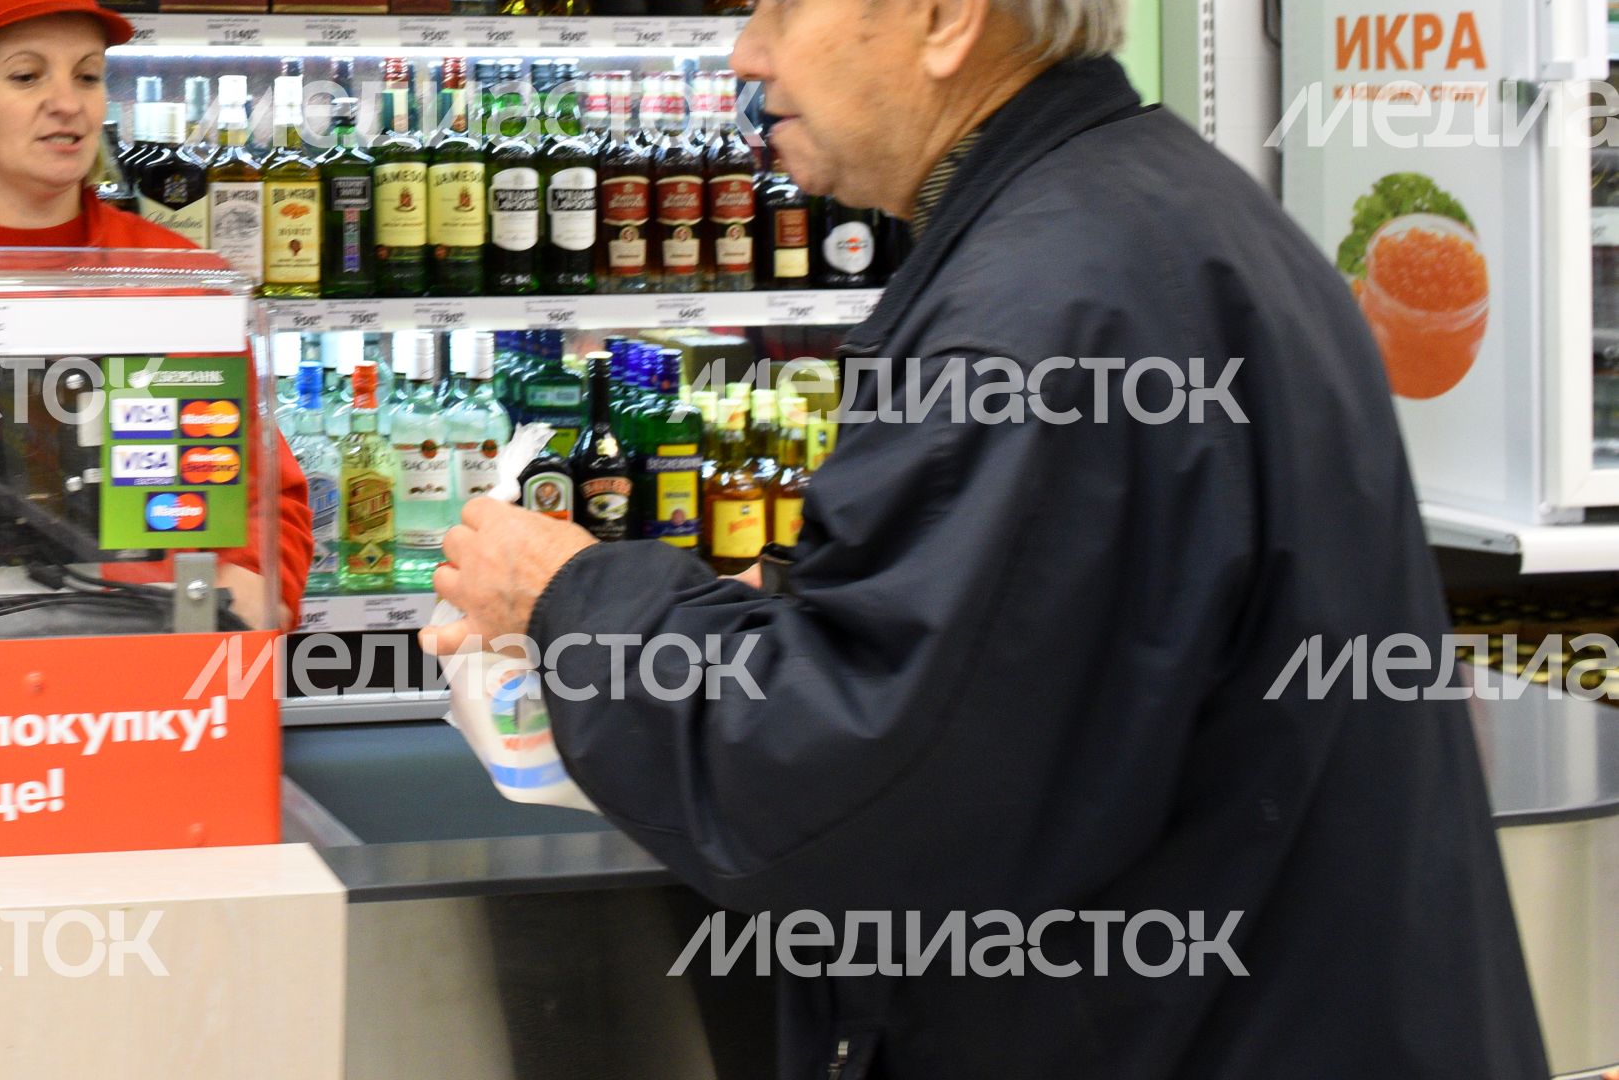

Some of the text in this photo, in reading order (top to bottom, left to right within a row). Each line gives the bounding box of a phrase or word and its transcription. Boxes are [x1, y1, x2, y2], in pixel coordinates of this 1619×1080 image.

[1334, 10, 1488, 73] ИКРА
[120, 404, 173, 424] VISA
[120, 451, 171, 471] VISA
